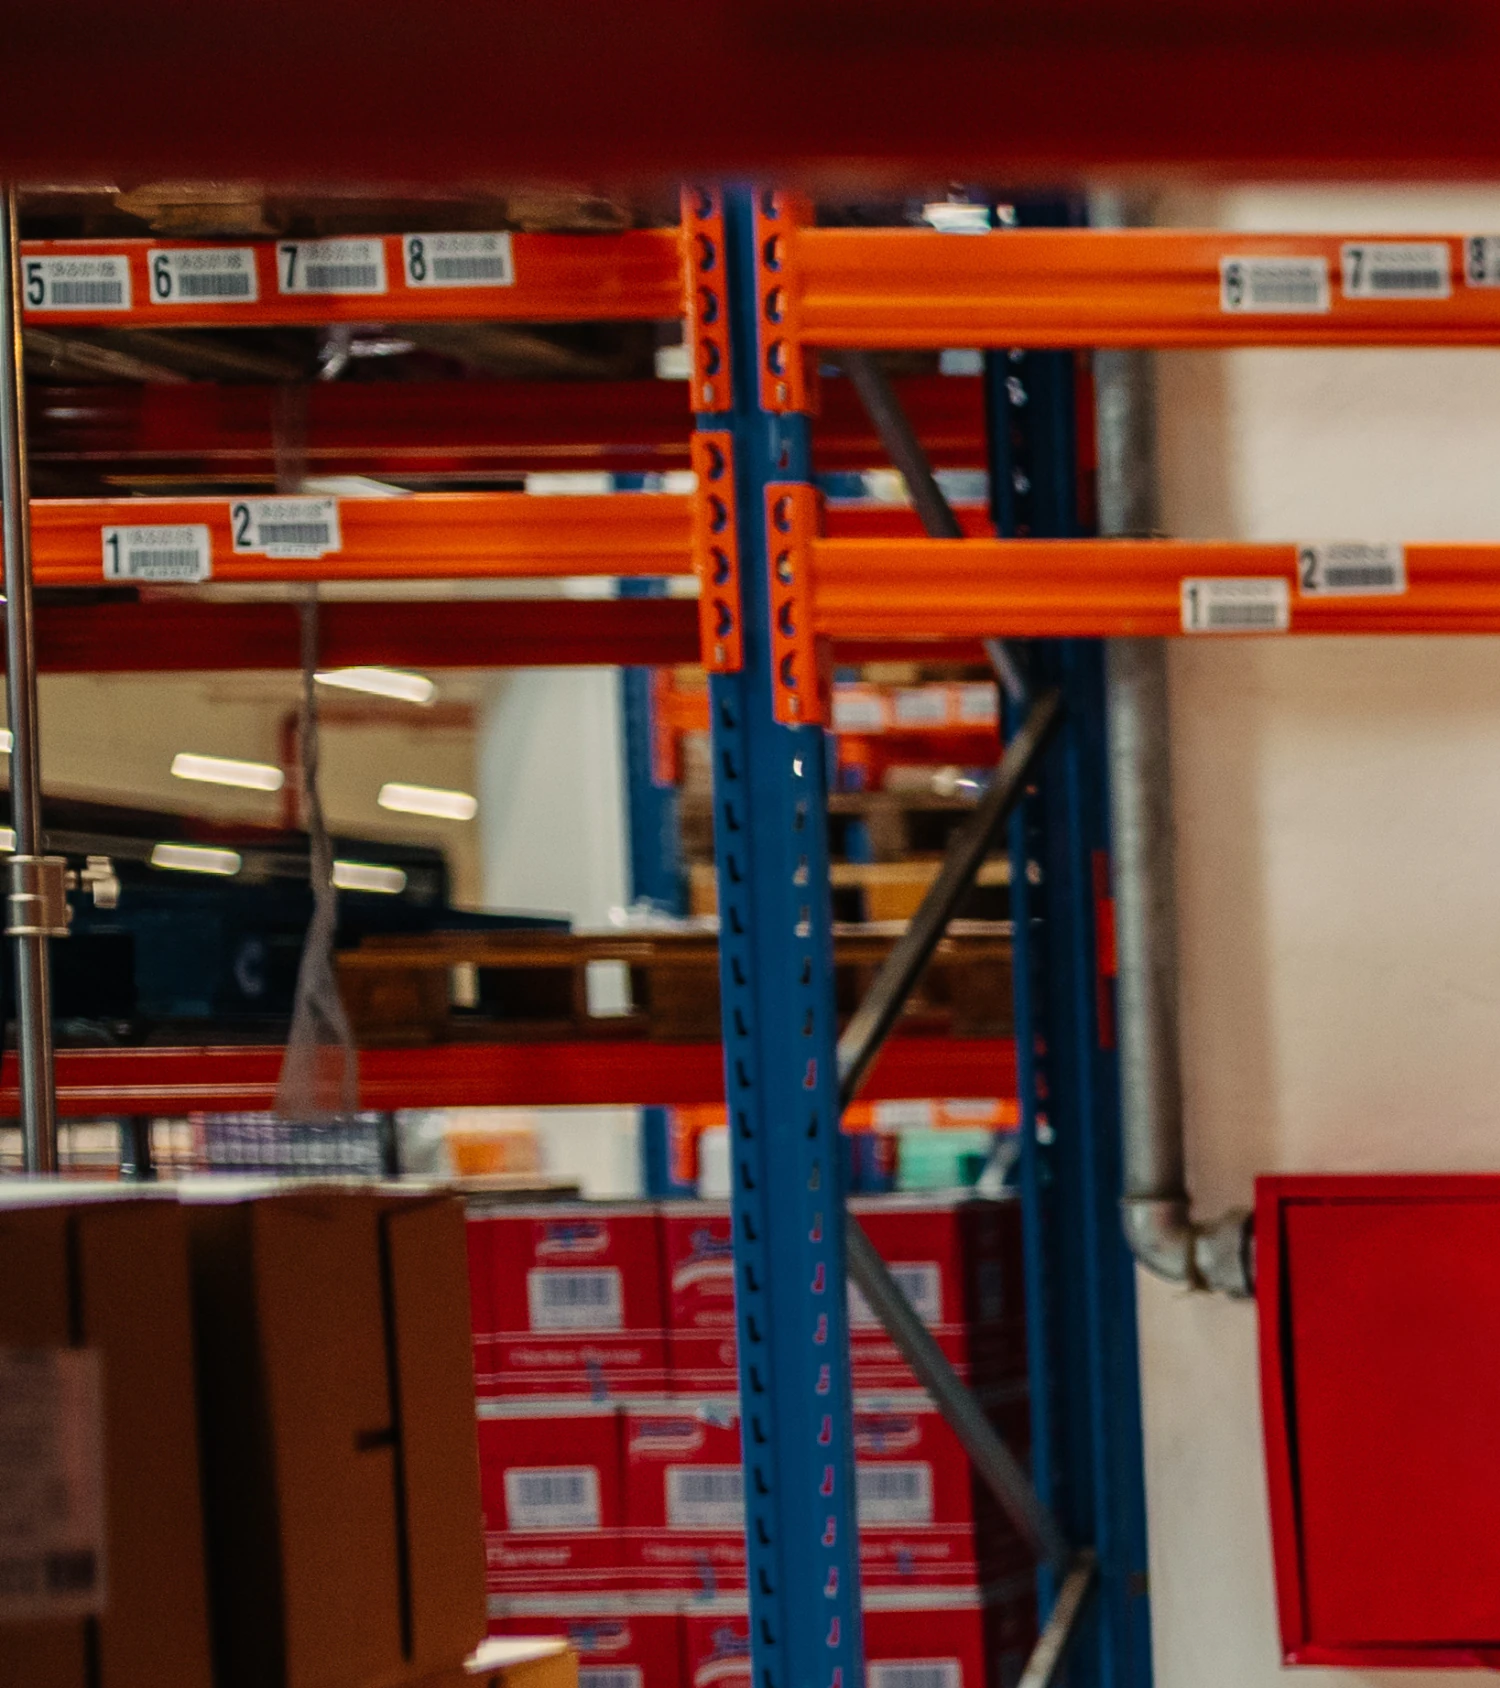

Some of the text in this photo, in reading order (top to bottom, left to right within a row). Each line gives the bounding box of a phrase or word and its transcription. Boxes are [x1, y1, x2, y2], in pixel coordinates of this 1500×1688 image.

[154, 256, 171, 298] 6
[281, 246, 298, 288] 7
[409, 239, 427, 281] 8
[1346, 249, 1364, 289] 7
[27, 263, 45, 305] 5
[233, 503, 252, 546] 2
[105, 533, 121, 574] 1
[1300, 548, 1319, 590] 2
